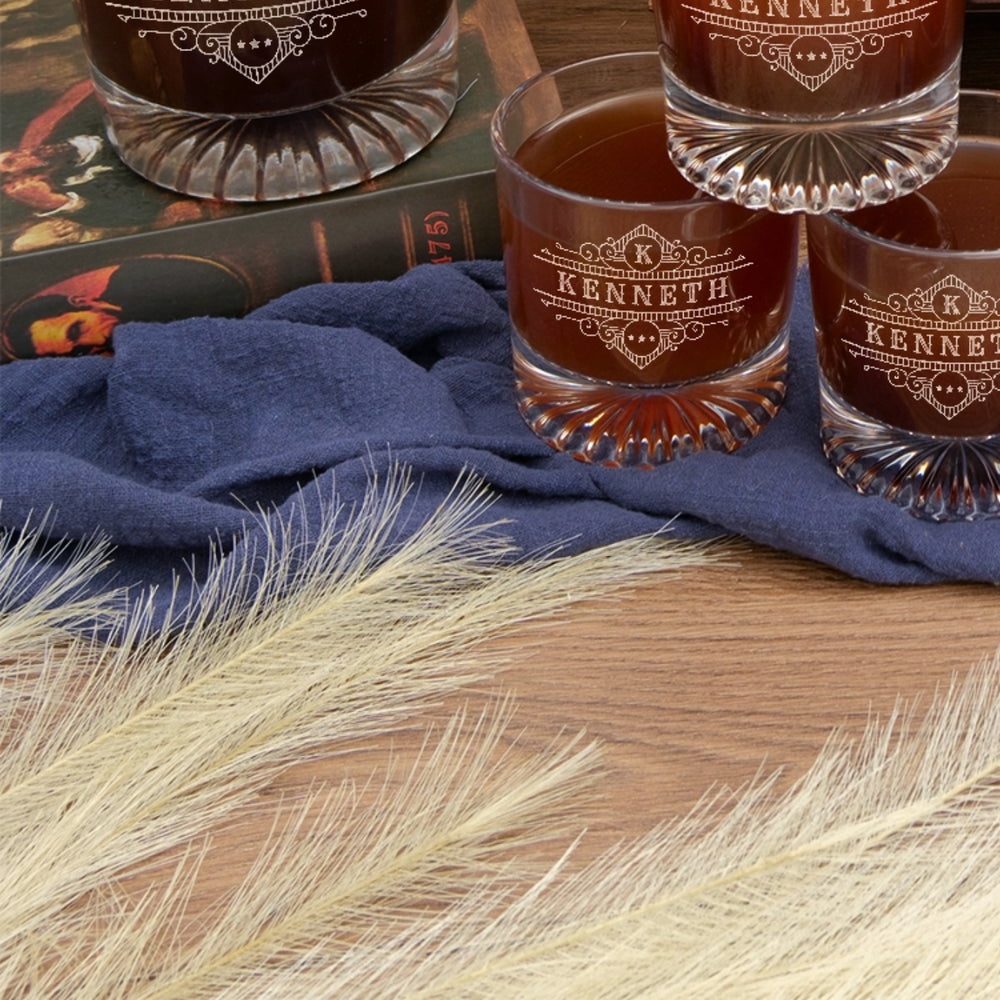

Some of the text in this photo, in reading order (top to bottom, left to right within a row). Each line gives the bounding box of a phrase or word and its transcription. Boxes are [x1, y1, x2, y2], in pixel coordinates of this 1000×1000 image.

[634, 244, 653, 265] K
[557, 271, 729, 306] KENNETH
[942, 294, 961, 315] K
